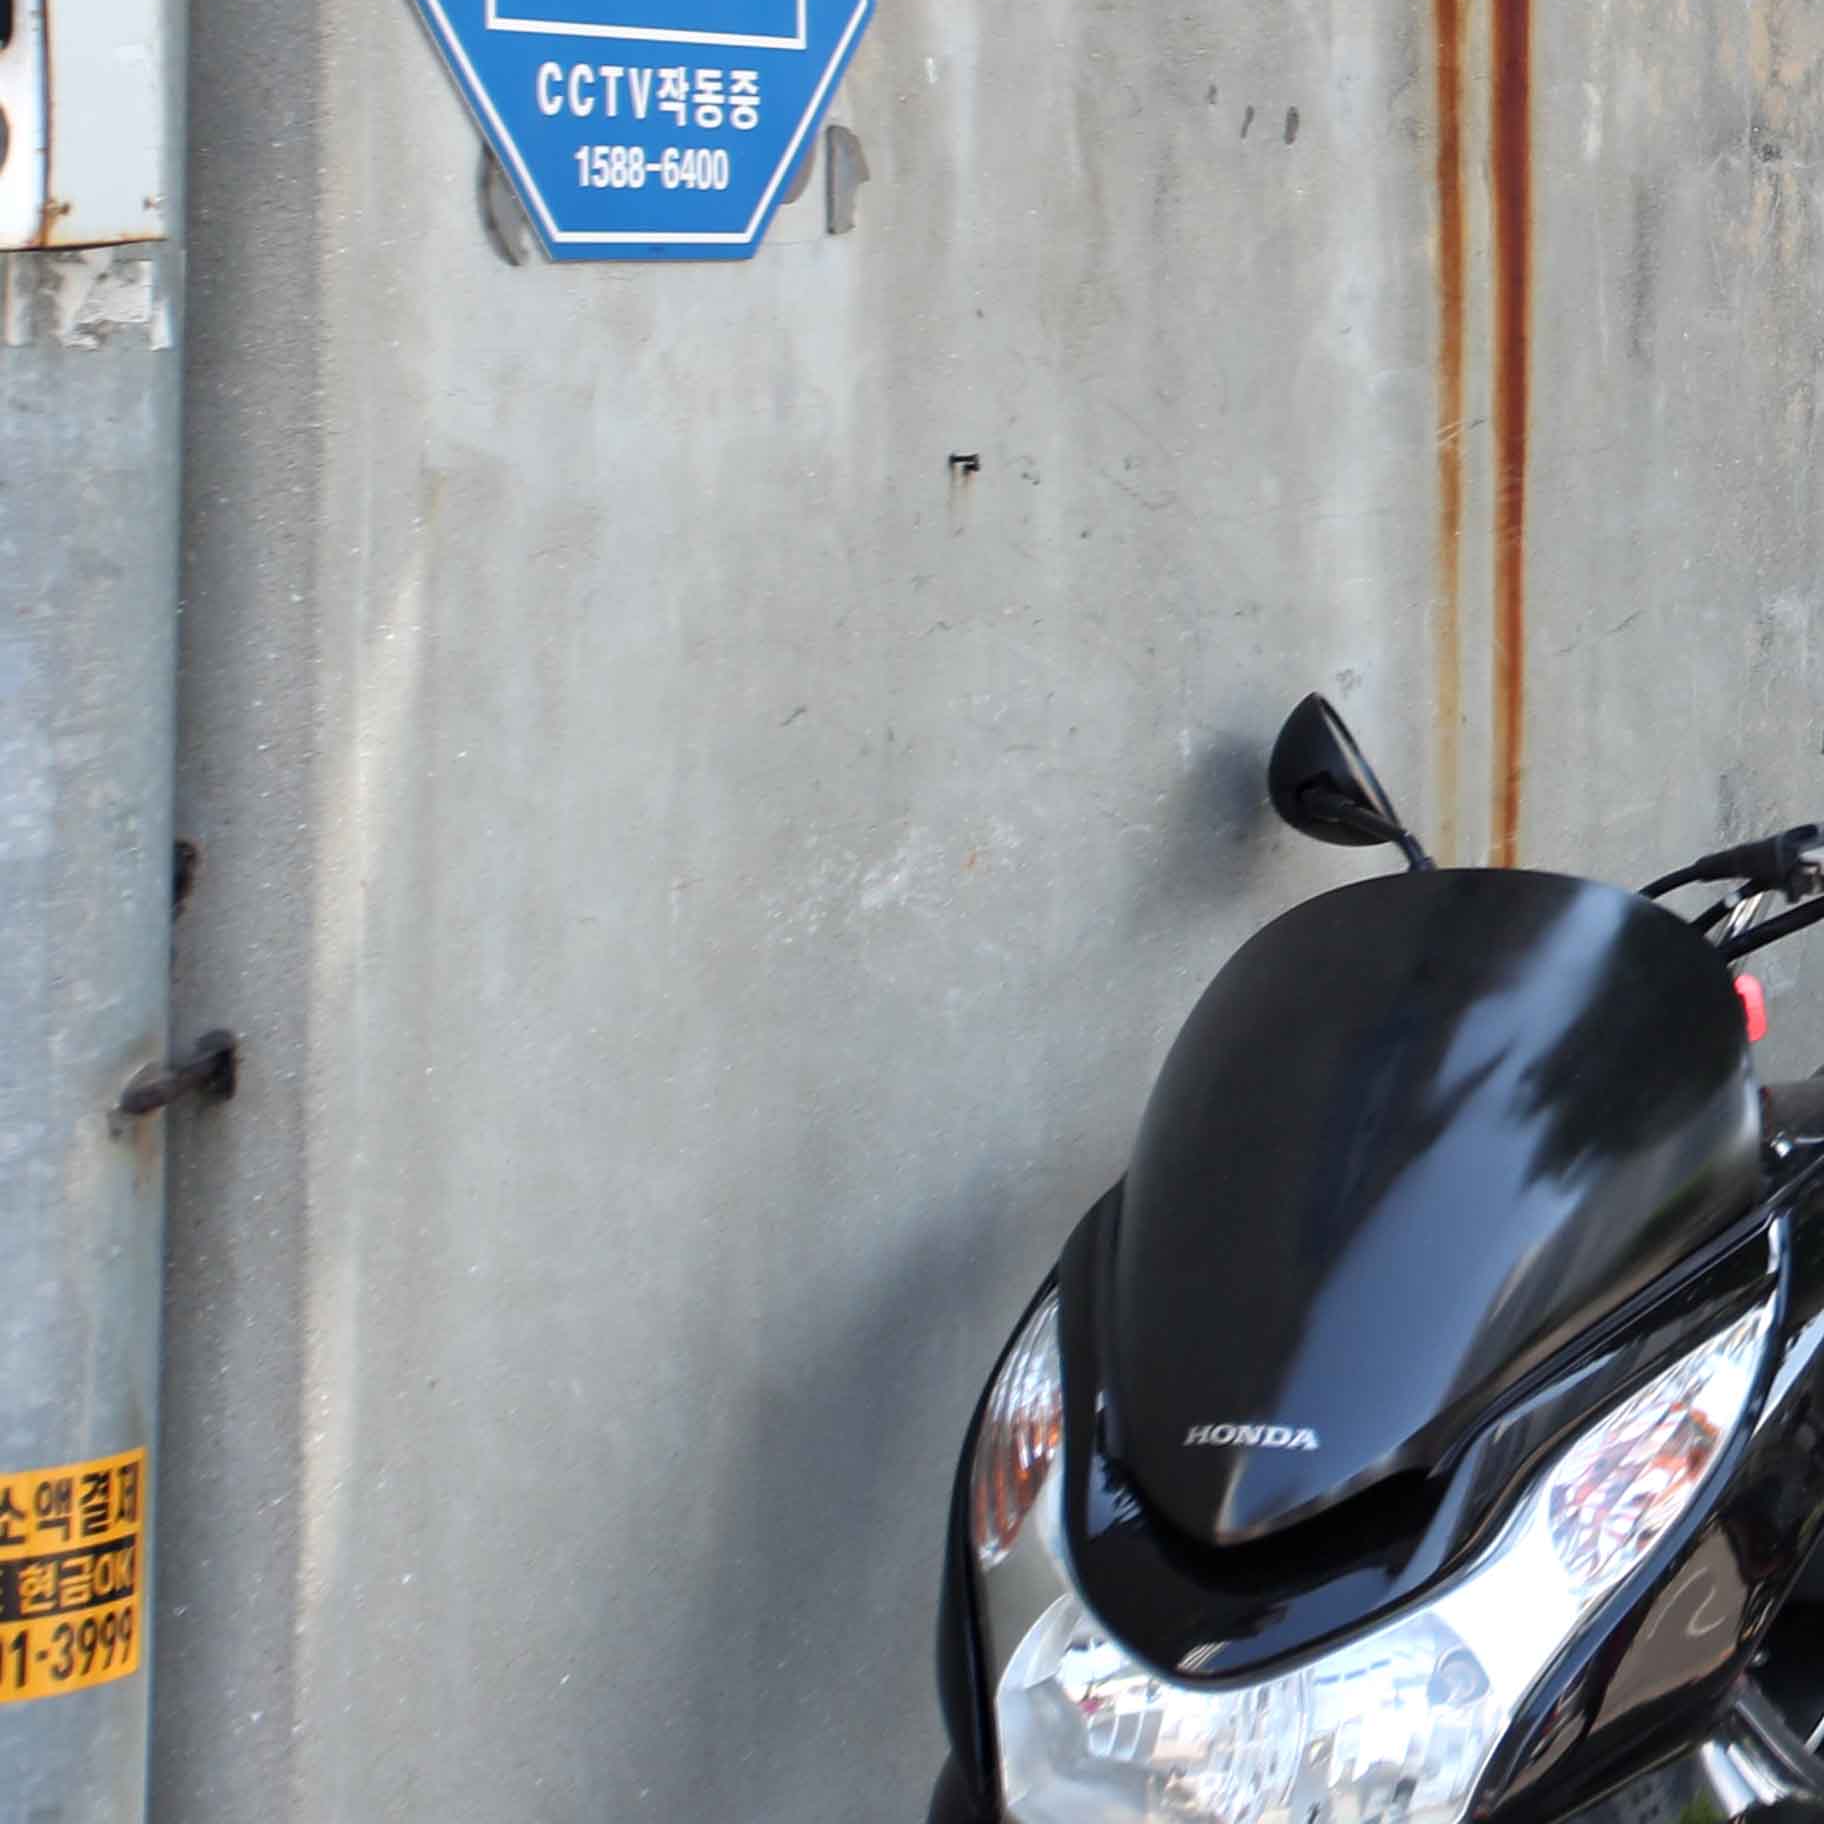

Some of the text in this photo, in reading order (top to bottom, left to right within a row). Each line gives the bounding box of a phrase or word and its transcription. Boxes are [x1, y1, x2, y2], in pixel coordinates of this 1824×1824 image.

[537, 61, 761, 130] CCTV작동중
[574, 145, 729, 190] 1588-6400
[1183, 1424, 1319, 1451] HONDA
